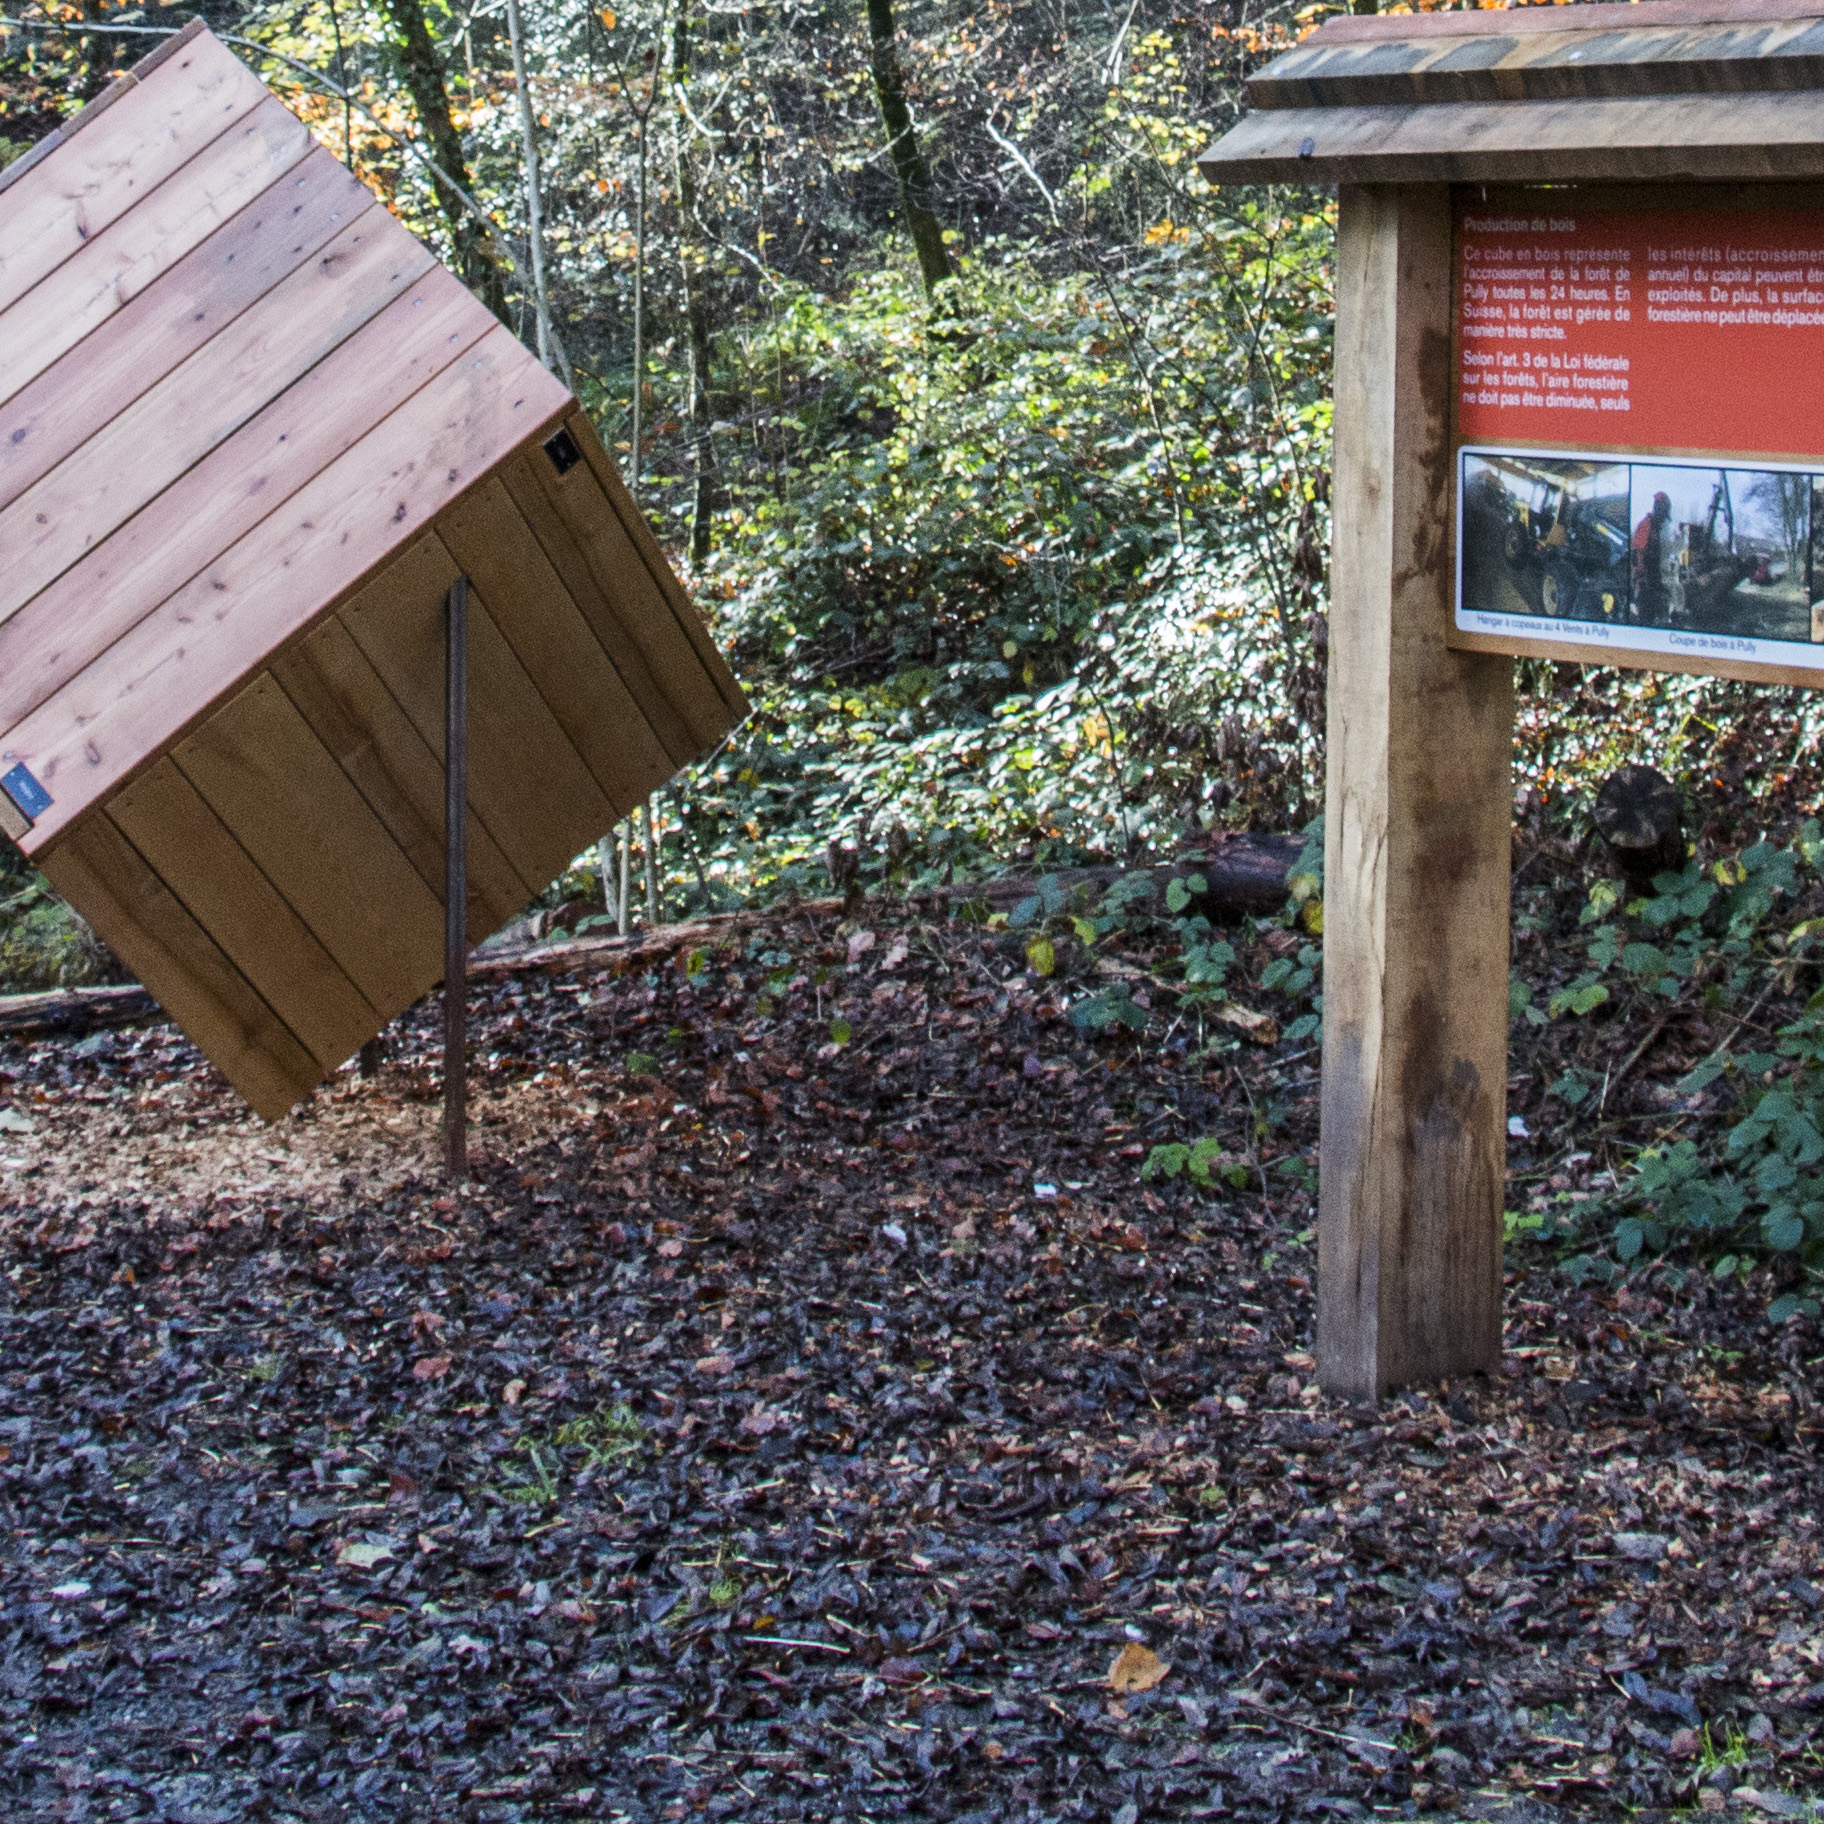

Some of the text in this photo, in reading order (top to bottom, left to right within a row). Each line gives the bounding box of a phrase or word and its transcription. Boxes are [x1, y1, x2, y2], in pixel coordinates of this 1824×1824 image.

[1465, 217, 1576, 232] Production de bois
[1464, 244, 1631, 263] Ce cube en bois représente
[1647, 247, 1667, 262] les
[1670, 246, 1721, 262] intérêts
[1464, 265, 1630, 281] l'accroissement de la forêt de
[1647, 266, 1689, 283] annuel)
[1693, 267, 1709, 282] du
[1712, 267, 1752, 285] capital
[1755, 268, 1804, 286] peuvent
[1464, 283, 1631, 303] Pully toutes les 24 heures. En
[1647, 286, 1706, 305] exploités.
[1710, 286, 1728, 303] De
[1732, 287, 1763, 306] plus,
[1766, 288, 1779, 304] la
[1463, 303, 1631, 324] Suisse, la forêt est gérée de
[1647, 305, 1702, 323] forestière
[1703, 310, 1718, 323] ne
[1718, 308, 1746, 328] peut
[1747, 308, 1771, 324] être
[1463, 323, 1567, 340] manière très stricte.
[1463, 349, 1630, 371] Selon l'art. 3 de la Loi fédérale
[1463, 370, 1629, 391] sur les forêts, l'aire forestière
[1463, 390, 1631, 411] ne doit pas être diminuée, seuls
